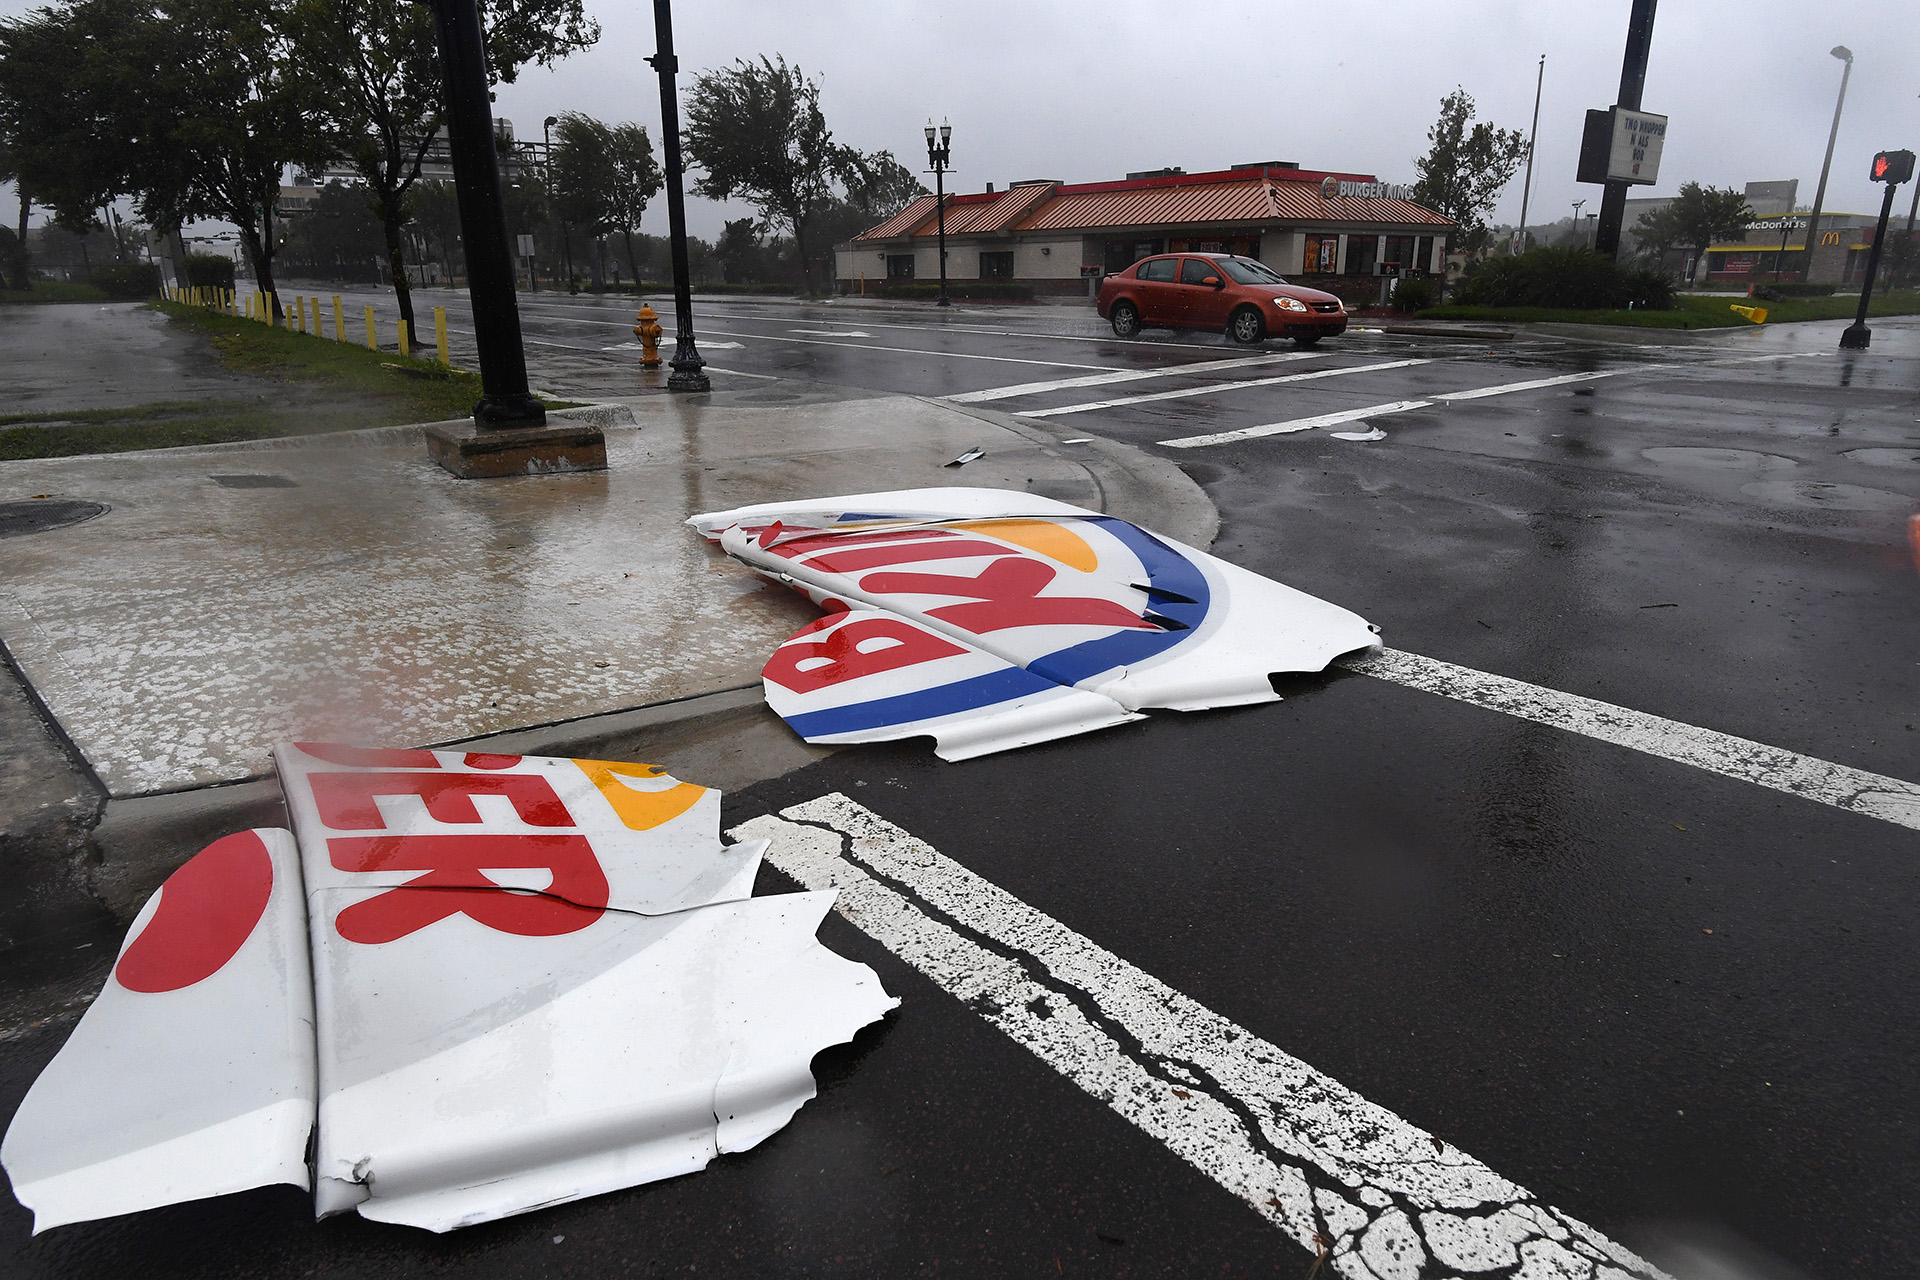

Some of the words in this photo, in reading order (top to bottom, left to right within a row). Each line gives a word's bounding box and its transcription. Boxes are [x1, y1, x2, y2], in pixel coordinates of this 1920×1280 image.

[1626, 117, 1637, 130] TWO
[1339, 181, 1384, 199] BURGER
[1386, 184, 1413, 200] KING
